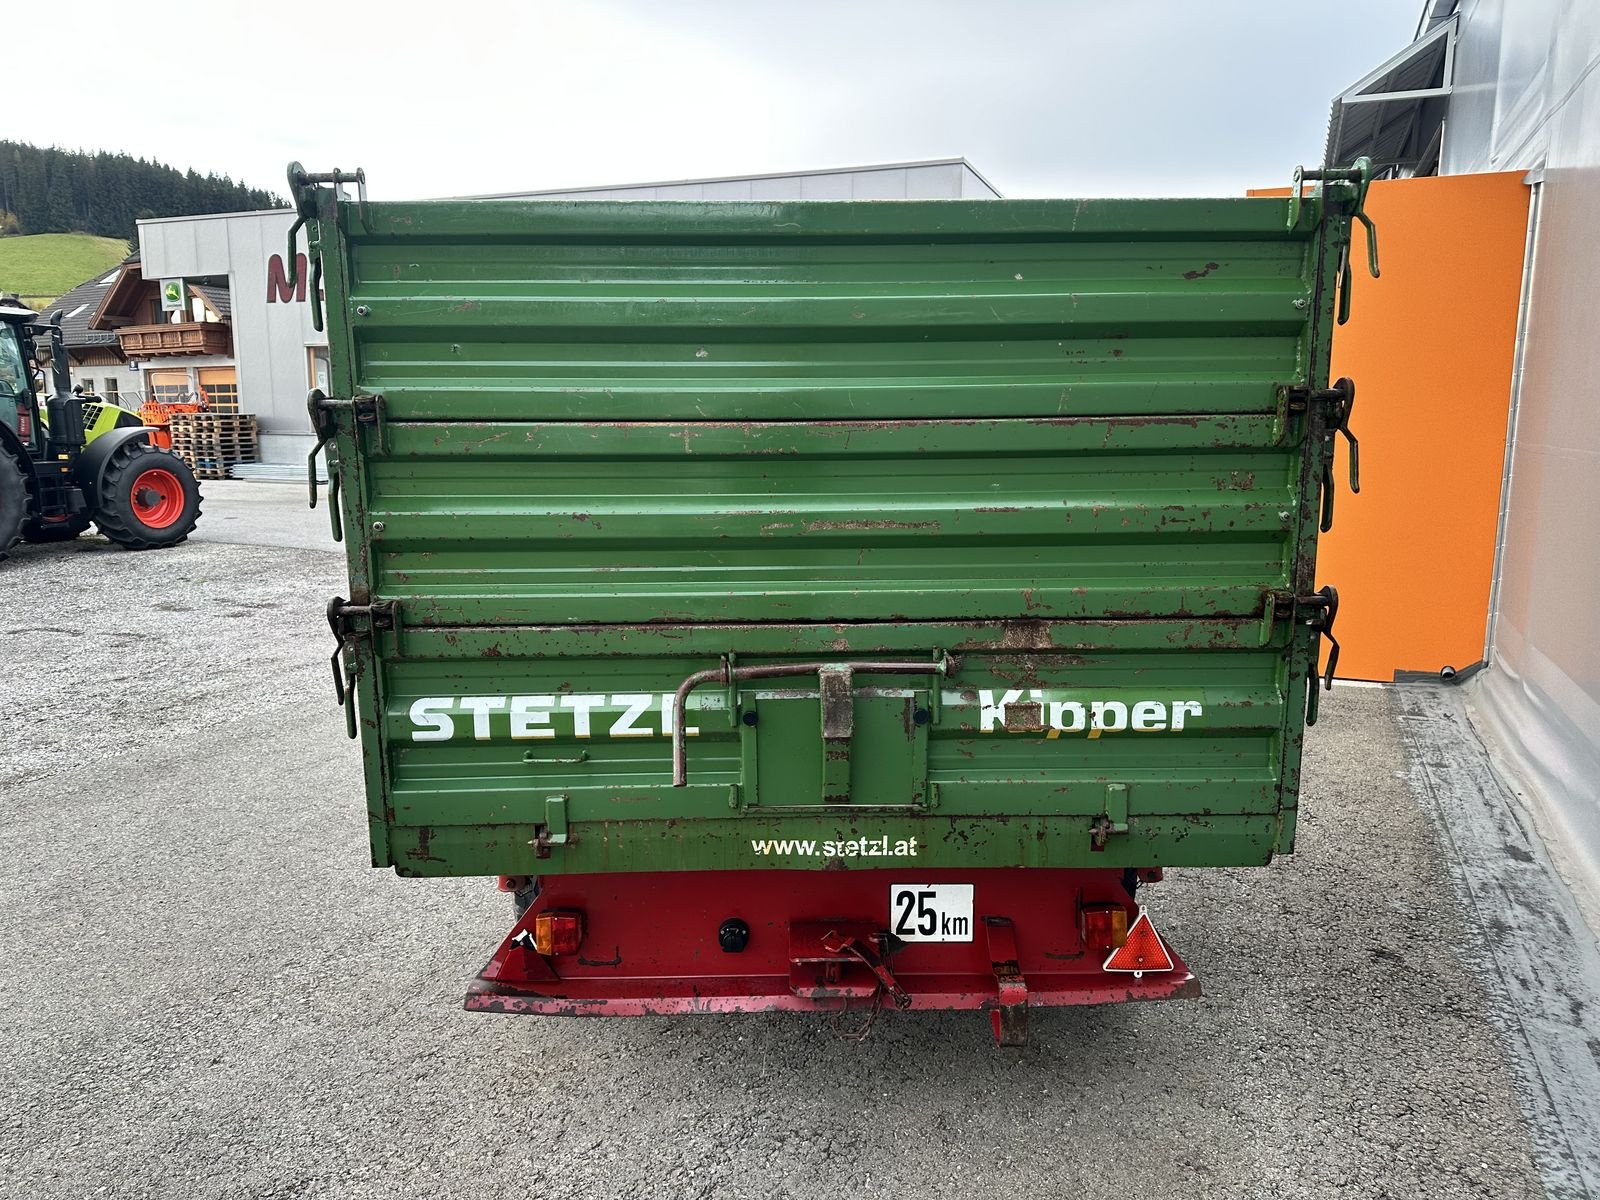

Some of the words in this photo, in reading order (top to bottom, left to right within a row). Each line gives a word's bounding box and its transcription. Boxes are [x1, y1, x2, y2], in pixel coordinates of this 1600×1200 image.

[266, 252, 325, 304] M
[409, 693, 700, 742] STETZL
[978, 689, 1203, 740] Kipper
[751, 835, 918, 858] www.stetzl.at
[895, 890, 938, 936] 25
[941, 911, 969, 936] km
